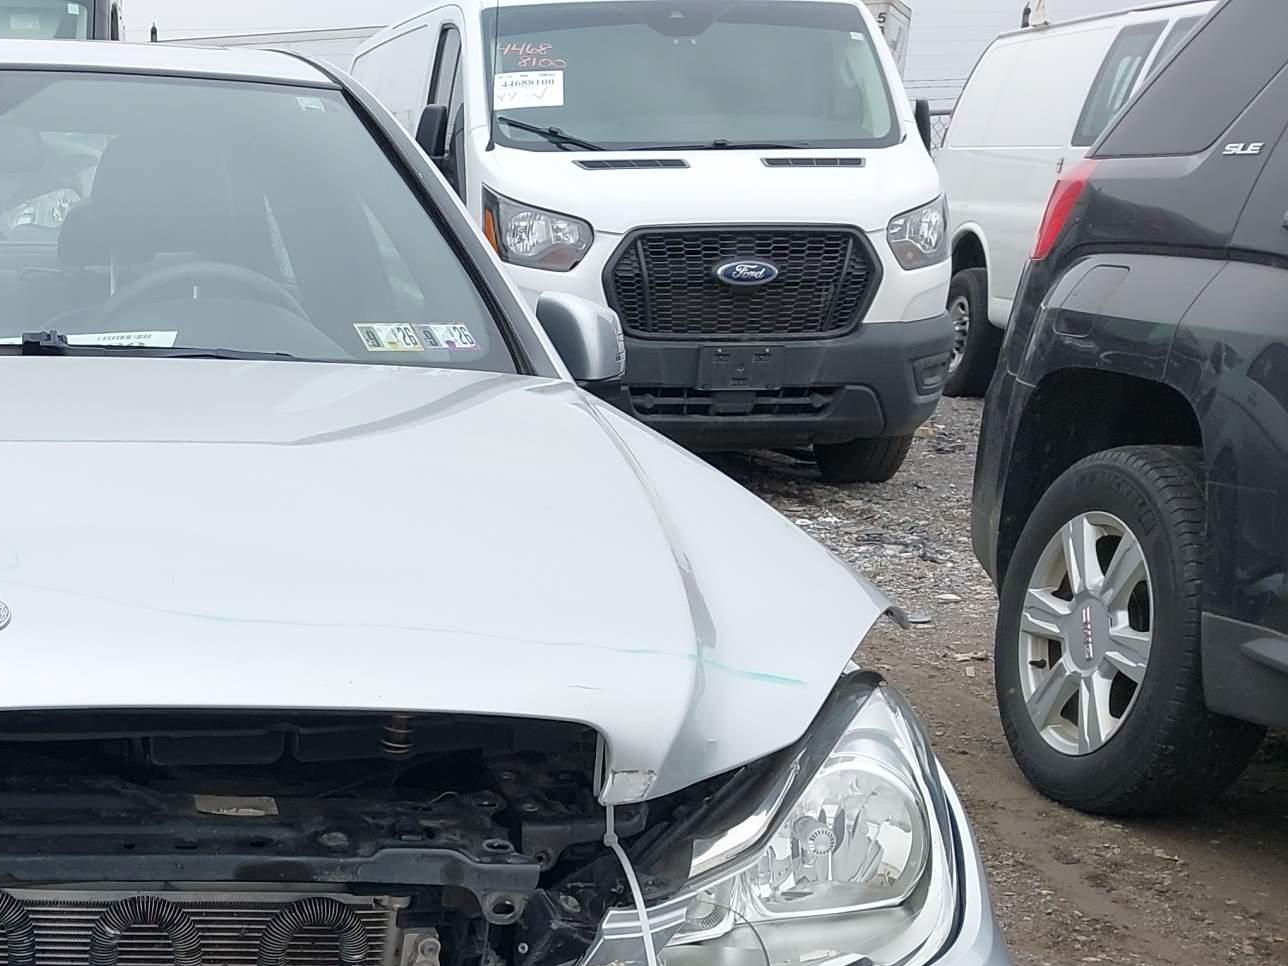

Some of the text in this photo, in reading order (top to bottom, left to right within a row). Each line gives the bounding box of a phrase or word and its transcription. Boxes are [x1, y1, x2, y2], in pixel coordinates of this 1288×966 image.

[519, 56, 567, 68] 8100
[1222, 142, 1265, 155] SLE
[732, 264, 766, 279] Ford
[396, 326, 418, 346] 26
[452, 326, 475, 345] 26
